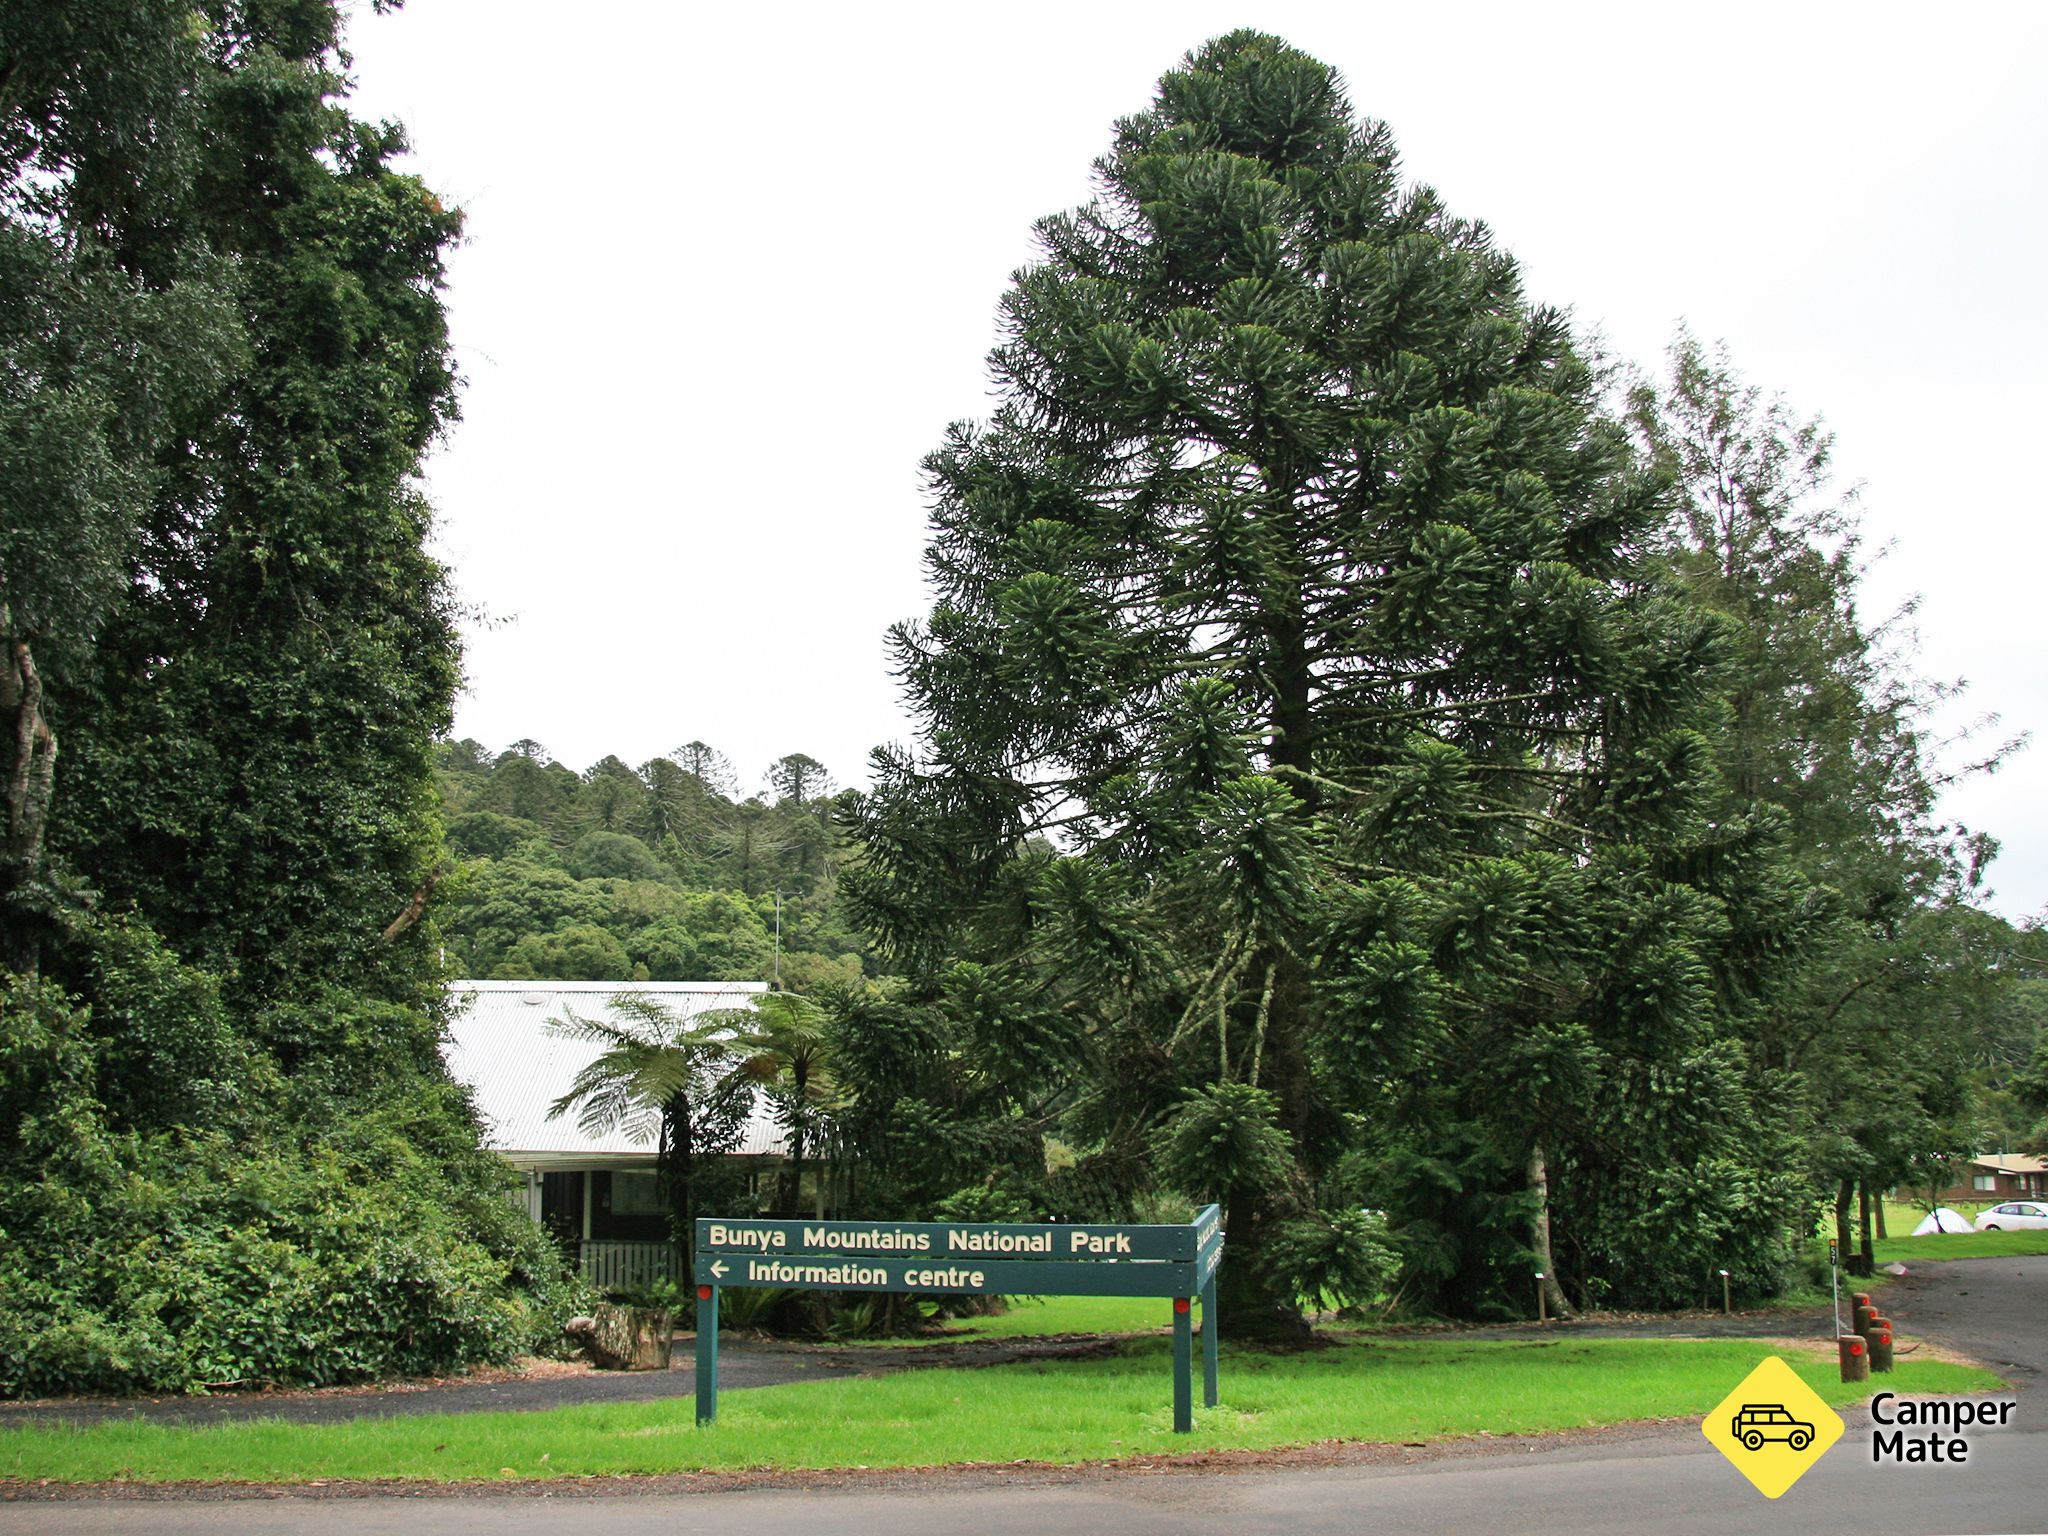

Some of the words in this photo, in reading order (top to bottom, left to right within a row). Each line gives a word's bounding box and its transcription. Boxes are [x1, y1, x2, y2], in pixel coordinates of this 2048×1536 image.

[709, 1225, 786, 1251] Bunya
[803, 1227, 930, 1250] Mountains
[948, 1229, 1052, 1252] National
[1070, 1231, 1132, 1253] Park
[748, 1260, 888, 1285] Information
[904, 1266, 985, 1288] centre
